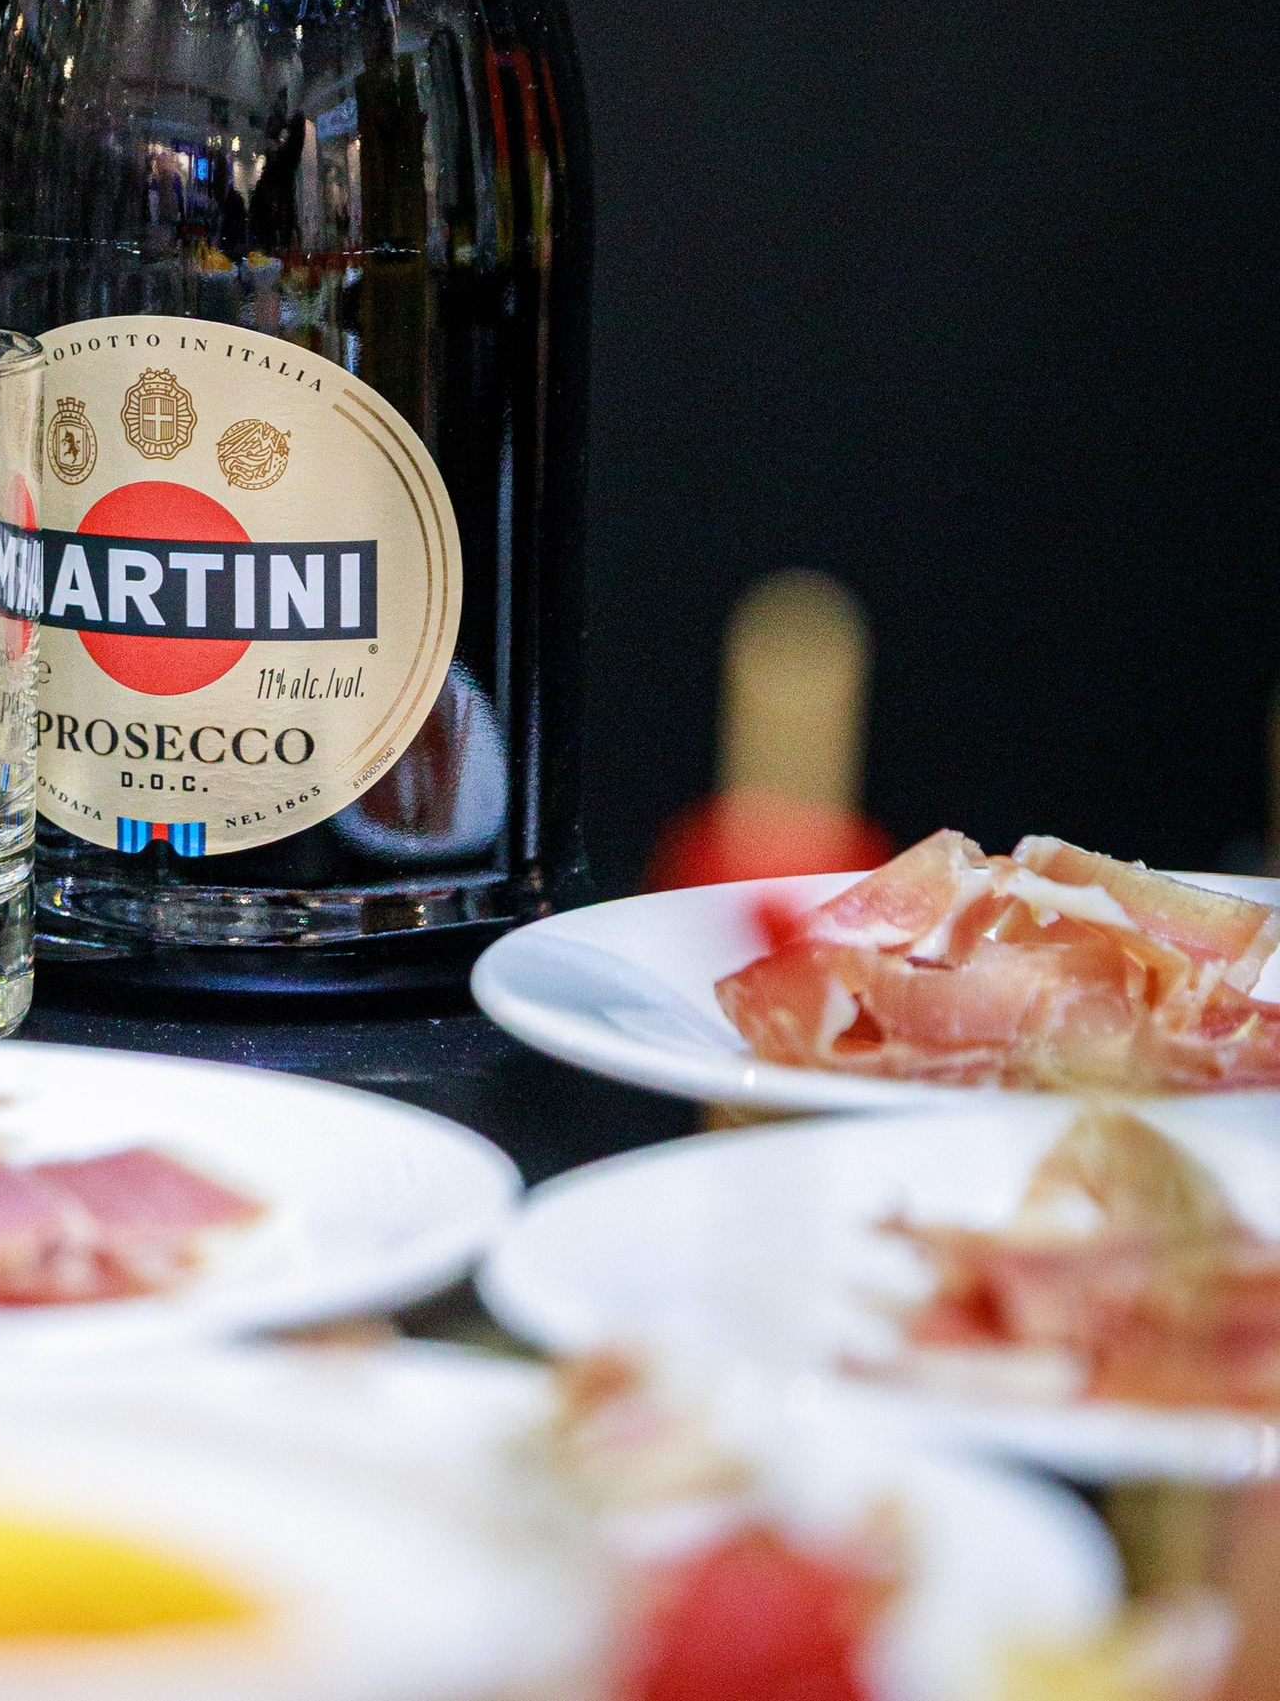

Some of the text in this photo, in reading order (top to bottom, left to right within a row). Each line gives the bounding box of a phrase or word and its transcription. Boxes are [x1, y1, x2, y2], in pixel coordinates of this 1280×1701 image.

[44, 333, 322, 393] ODOTTO IN ITALIA
[37, 710, 316, 766] PROSECCO
[120, 770, 209, 793] D.O.C.
[352, 746, 397, 790] 8140057040
[37, 775, 322, 830] ONDATA NEL 1863
